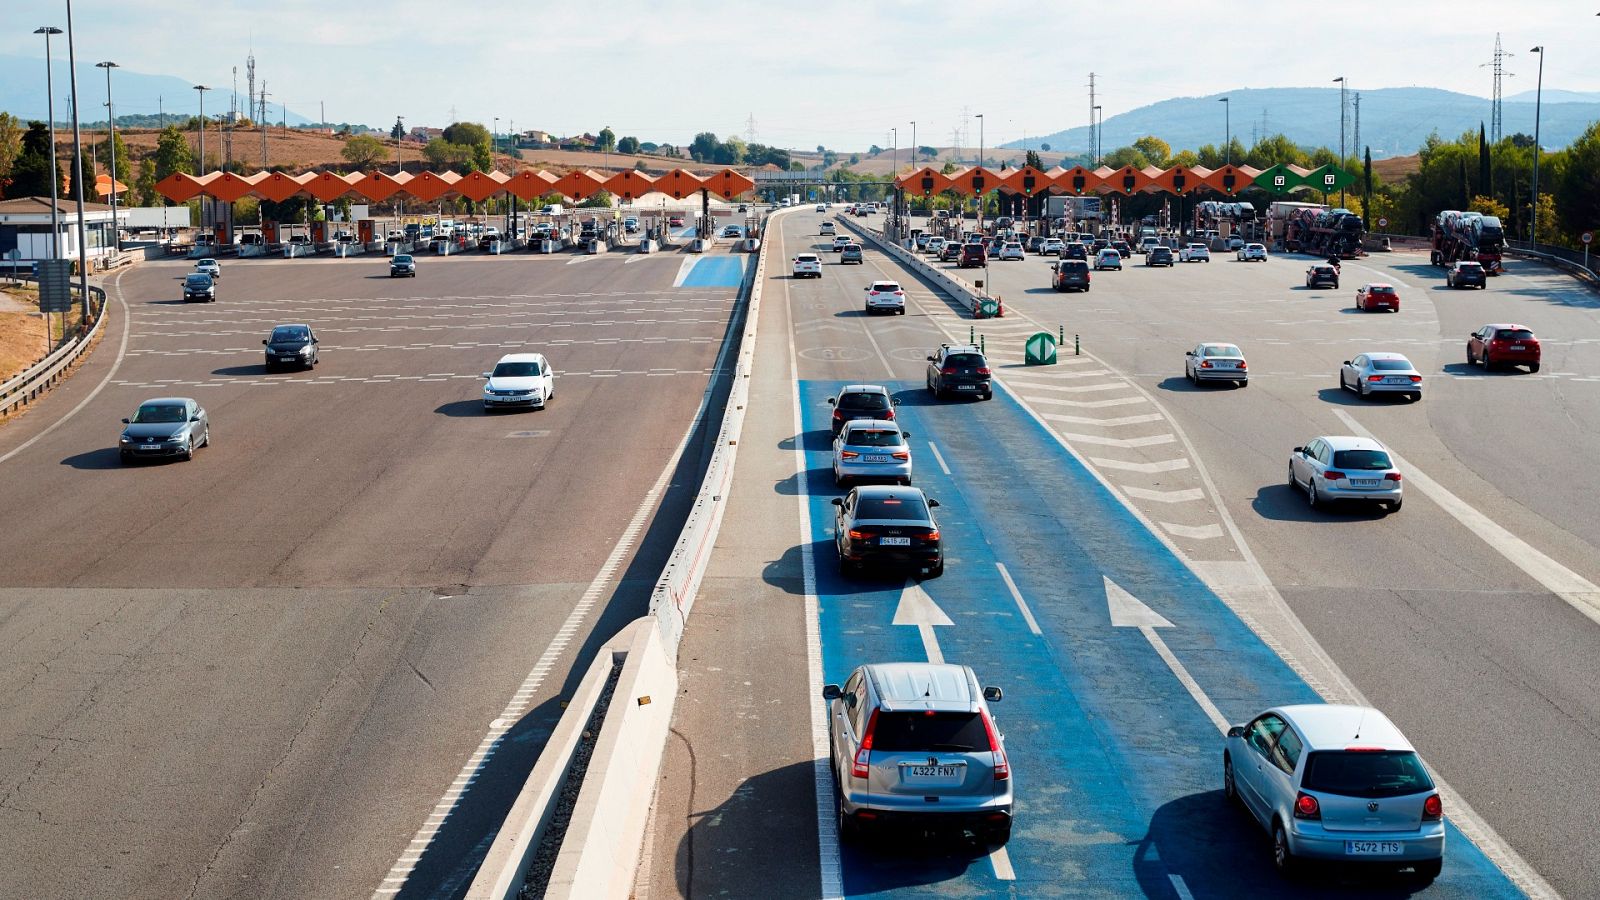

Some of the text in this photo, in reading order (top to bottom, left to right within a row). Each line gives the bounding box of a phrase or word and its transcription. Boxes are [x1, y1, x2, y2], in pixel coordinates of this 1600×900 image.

[913, 766, 955, 776] 4322 FNX
[1354, 842, 1399, 852] 5472 FTS
